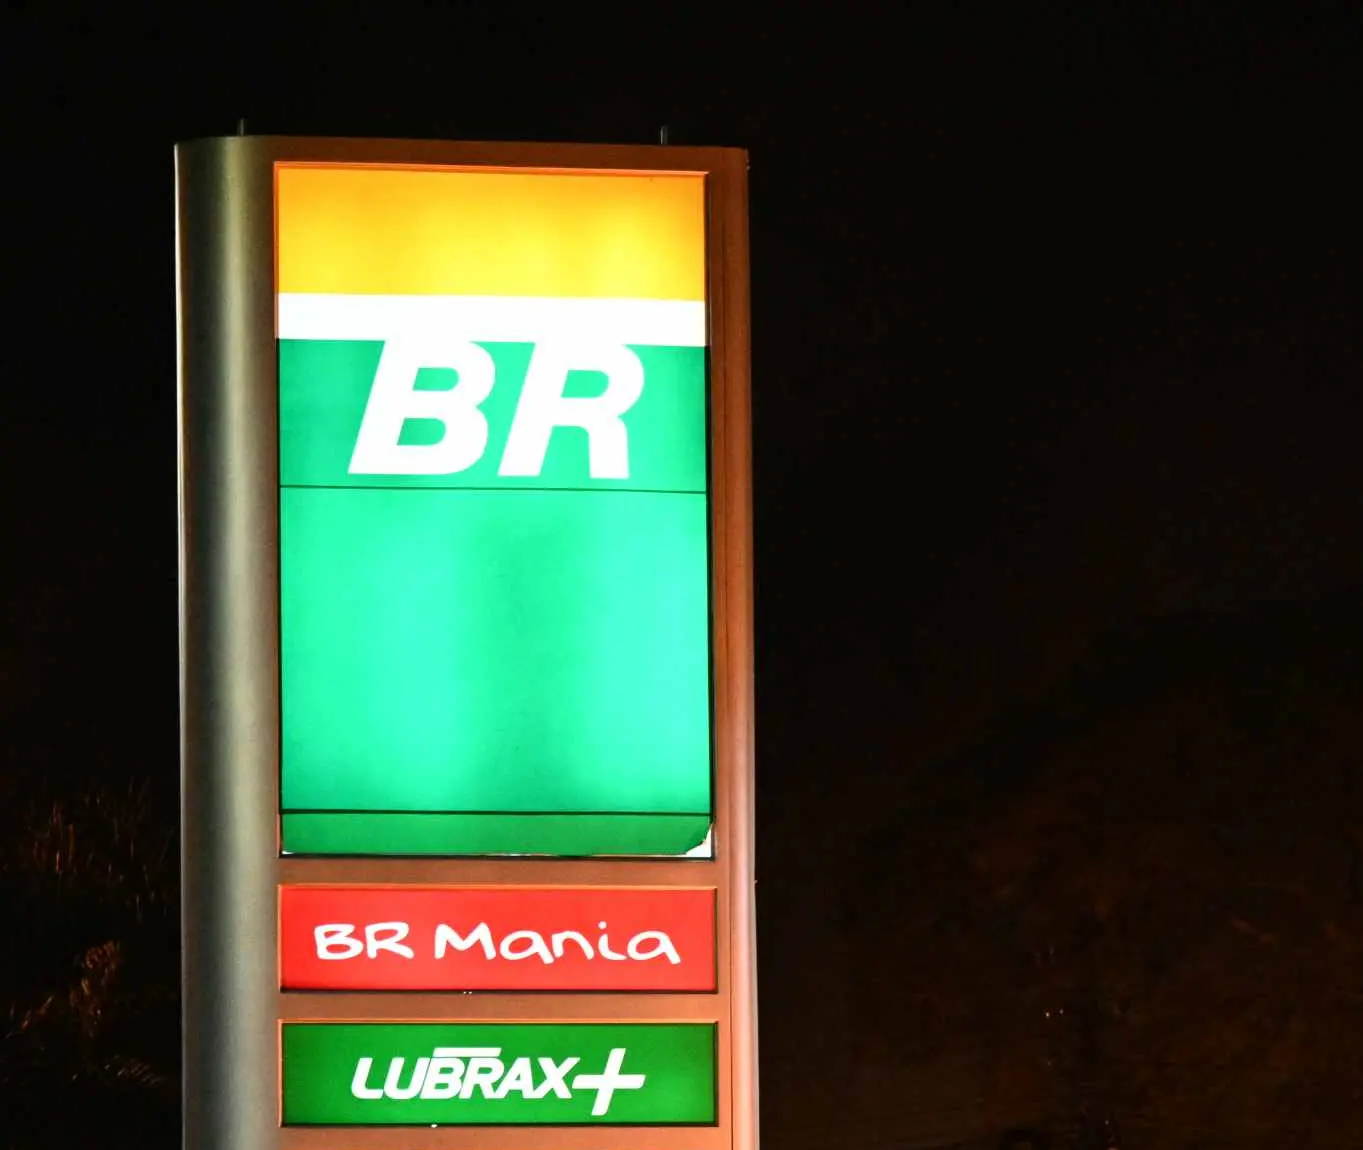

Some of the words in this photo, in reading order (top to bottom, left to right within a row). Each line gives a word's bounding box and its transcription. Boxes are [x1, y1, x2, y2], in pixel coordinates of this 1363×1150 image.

[347, 338, 645, 479] BR
[313, 922, 414, 960] BR
[434, 921, 681, 964] Mania
